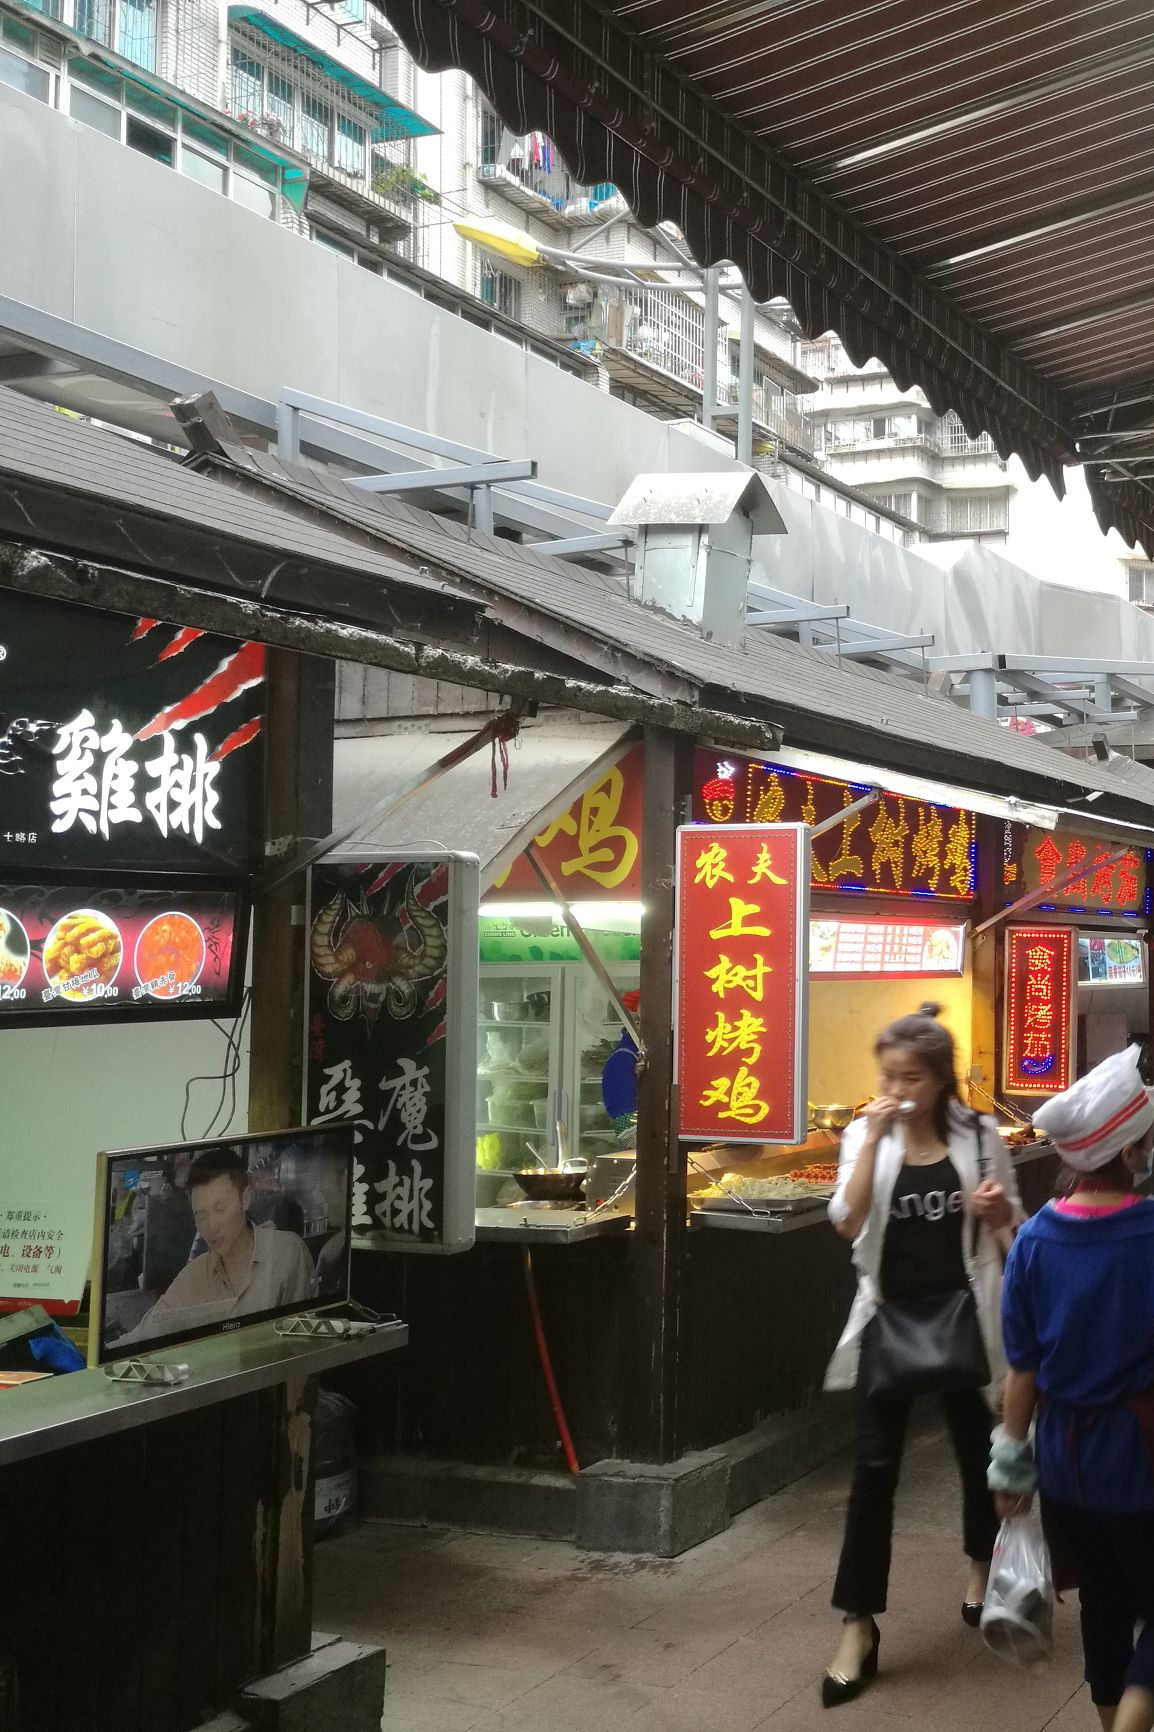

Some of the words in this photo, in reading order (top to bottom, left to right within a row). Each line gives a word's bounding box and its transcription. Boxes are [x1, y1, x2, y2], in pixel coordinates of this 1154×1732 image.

[50, 709, 222, 844] 雞排
[693, 842, 788, 889] 农夫
[699, 896, 773, 1126] 上树烤鸡
[1023, 944, 1054, 1058] 食尚烤茄
